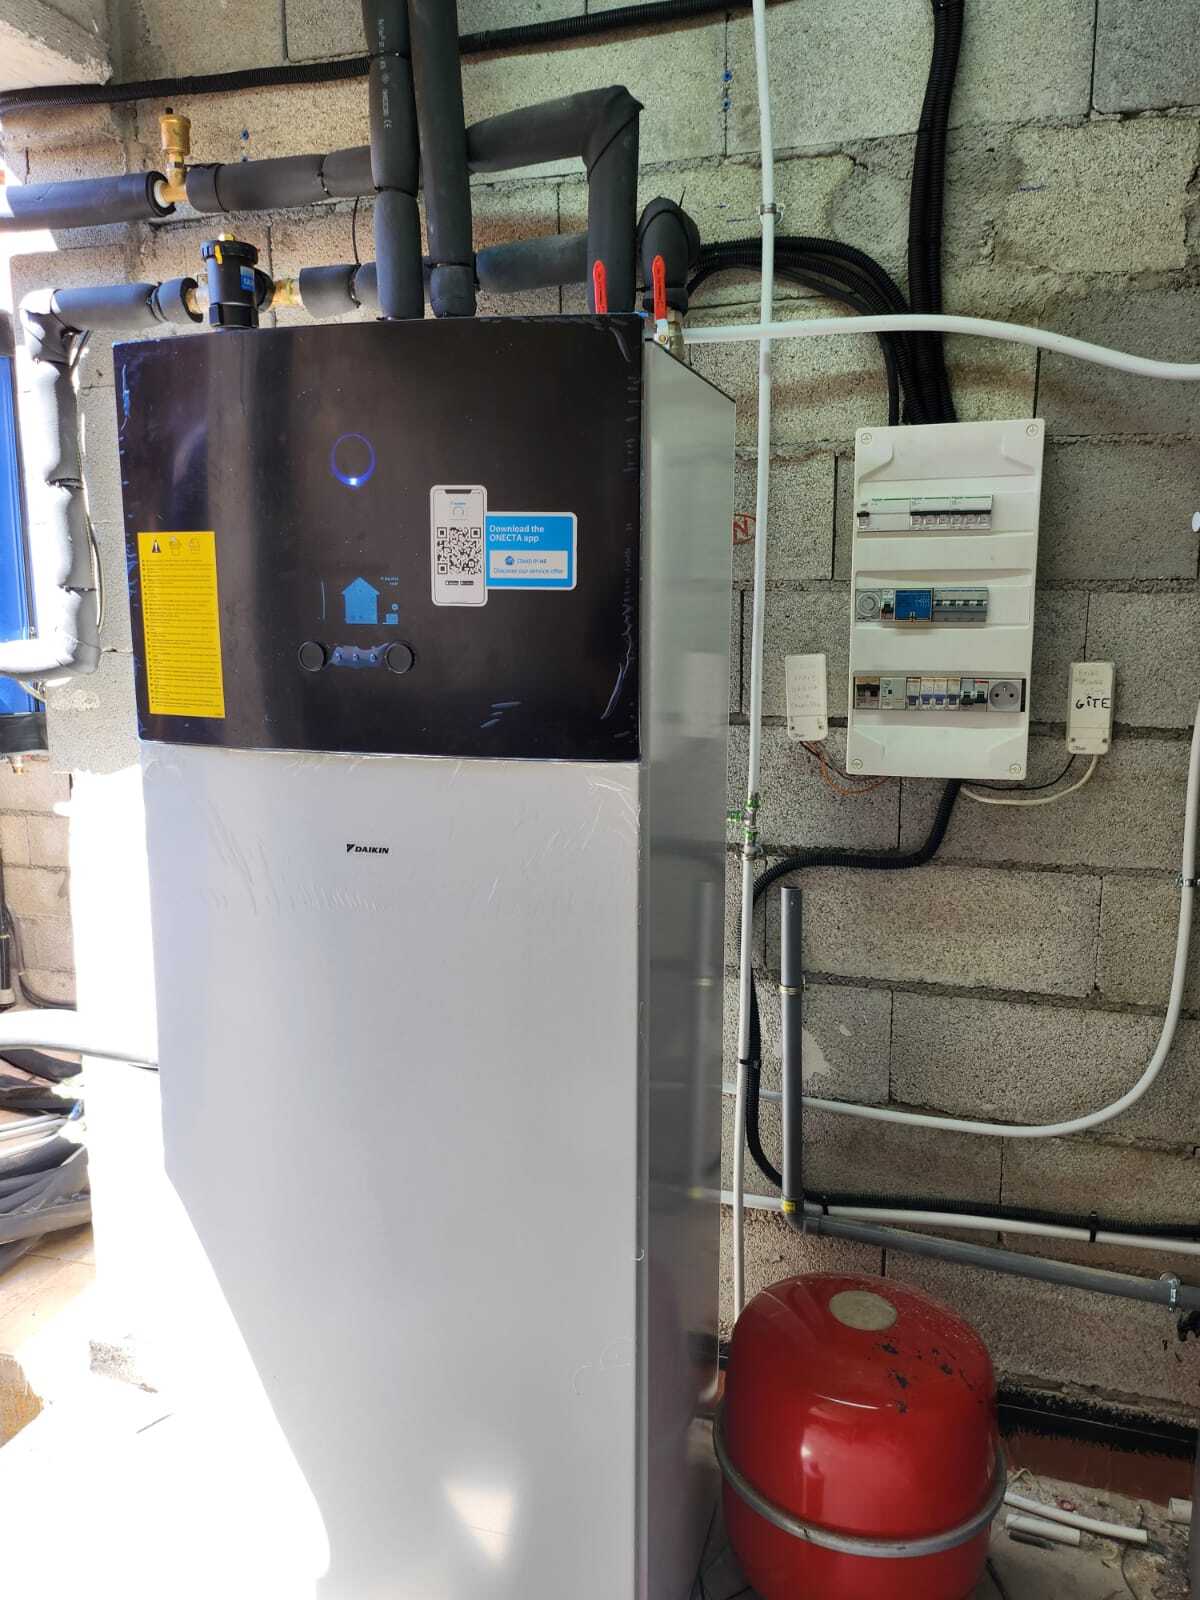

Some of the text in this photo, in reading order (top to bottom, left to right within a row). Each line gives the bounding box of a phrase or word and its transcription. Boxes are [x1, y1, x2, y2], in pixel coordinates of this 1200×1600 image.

[489, 524, 544, 533] Download the
[489, 534, 539, 544] ONECTA app
[355, 846, 390, 854] DAIKIN
